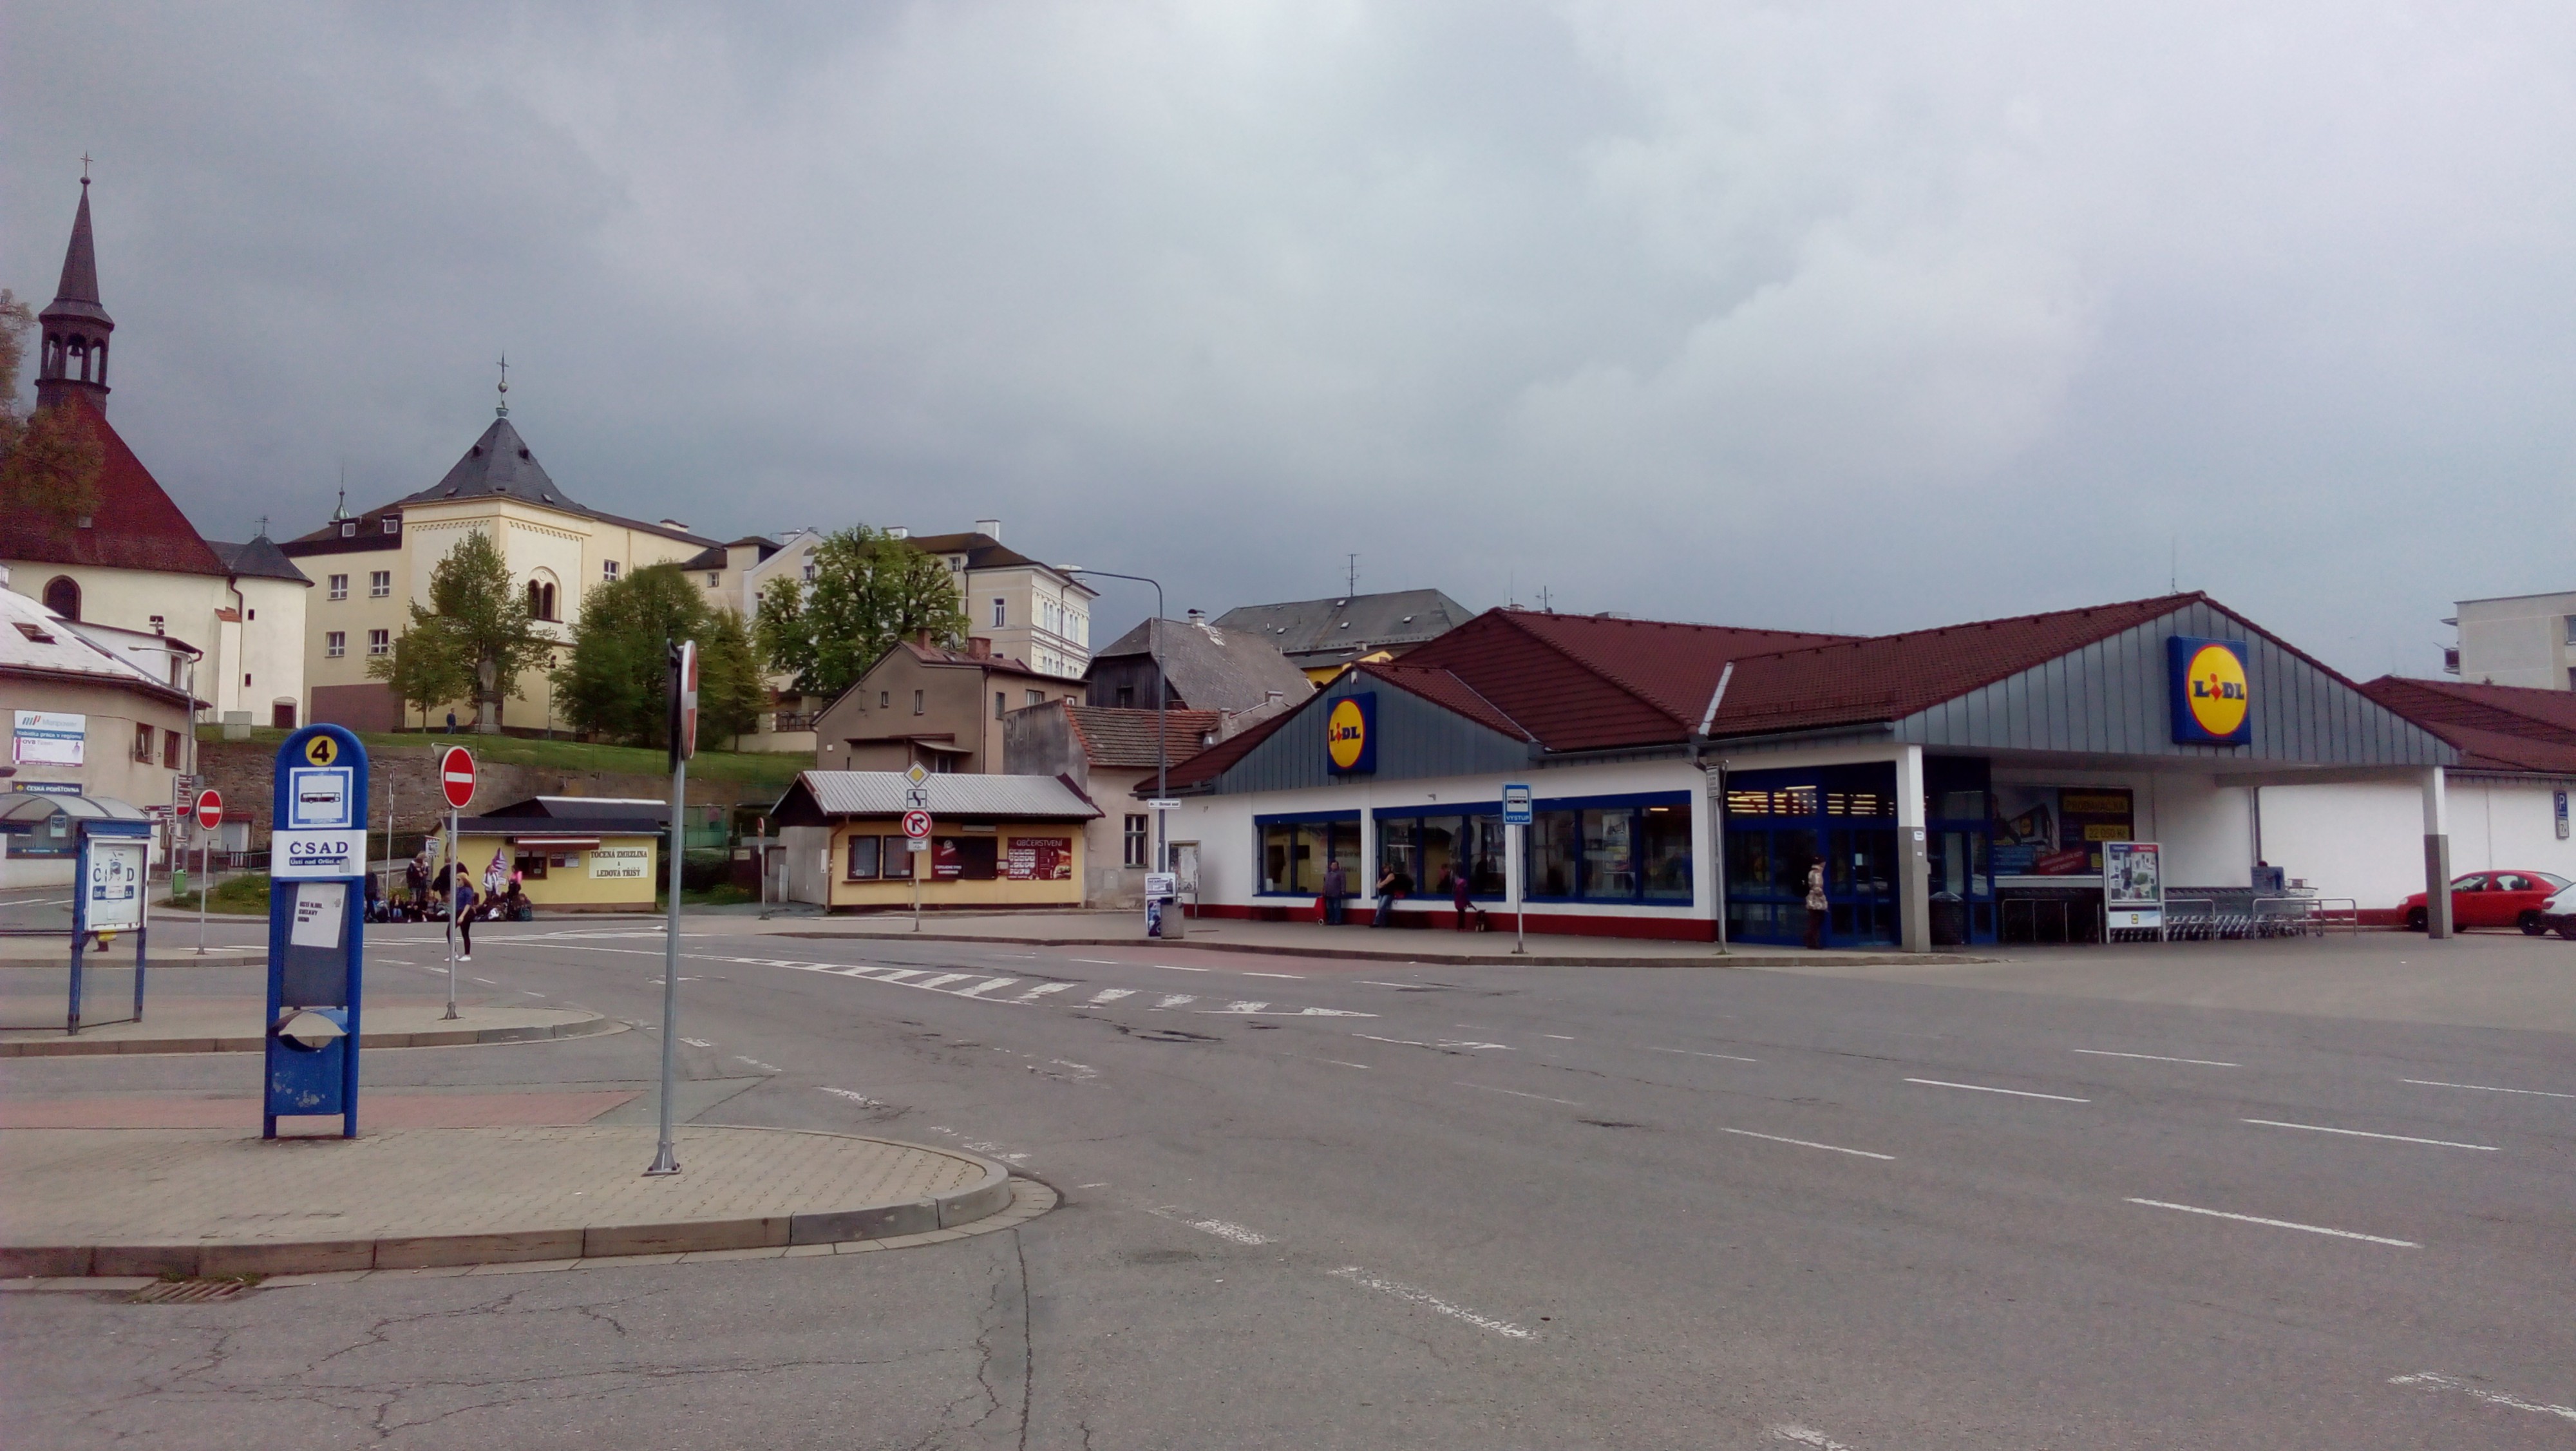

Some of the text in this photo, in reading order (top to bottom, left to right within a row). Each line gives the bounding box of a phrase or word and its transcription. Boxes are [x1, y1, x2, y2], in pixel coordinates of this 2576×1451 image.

[311, 740, 330, 763] 4
[2559, 795, 2565, 810] P
[290, 840, 348, 854] ČSAD
[1016, 838, 1063, 847] OBČERSTVENÍ
[591, 848, 615, 858] TOČENÁ
[93, 863, 134, 882] ČD
[596, 868, 621, 877] LEDOVÁ
